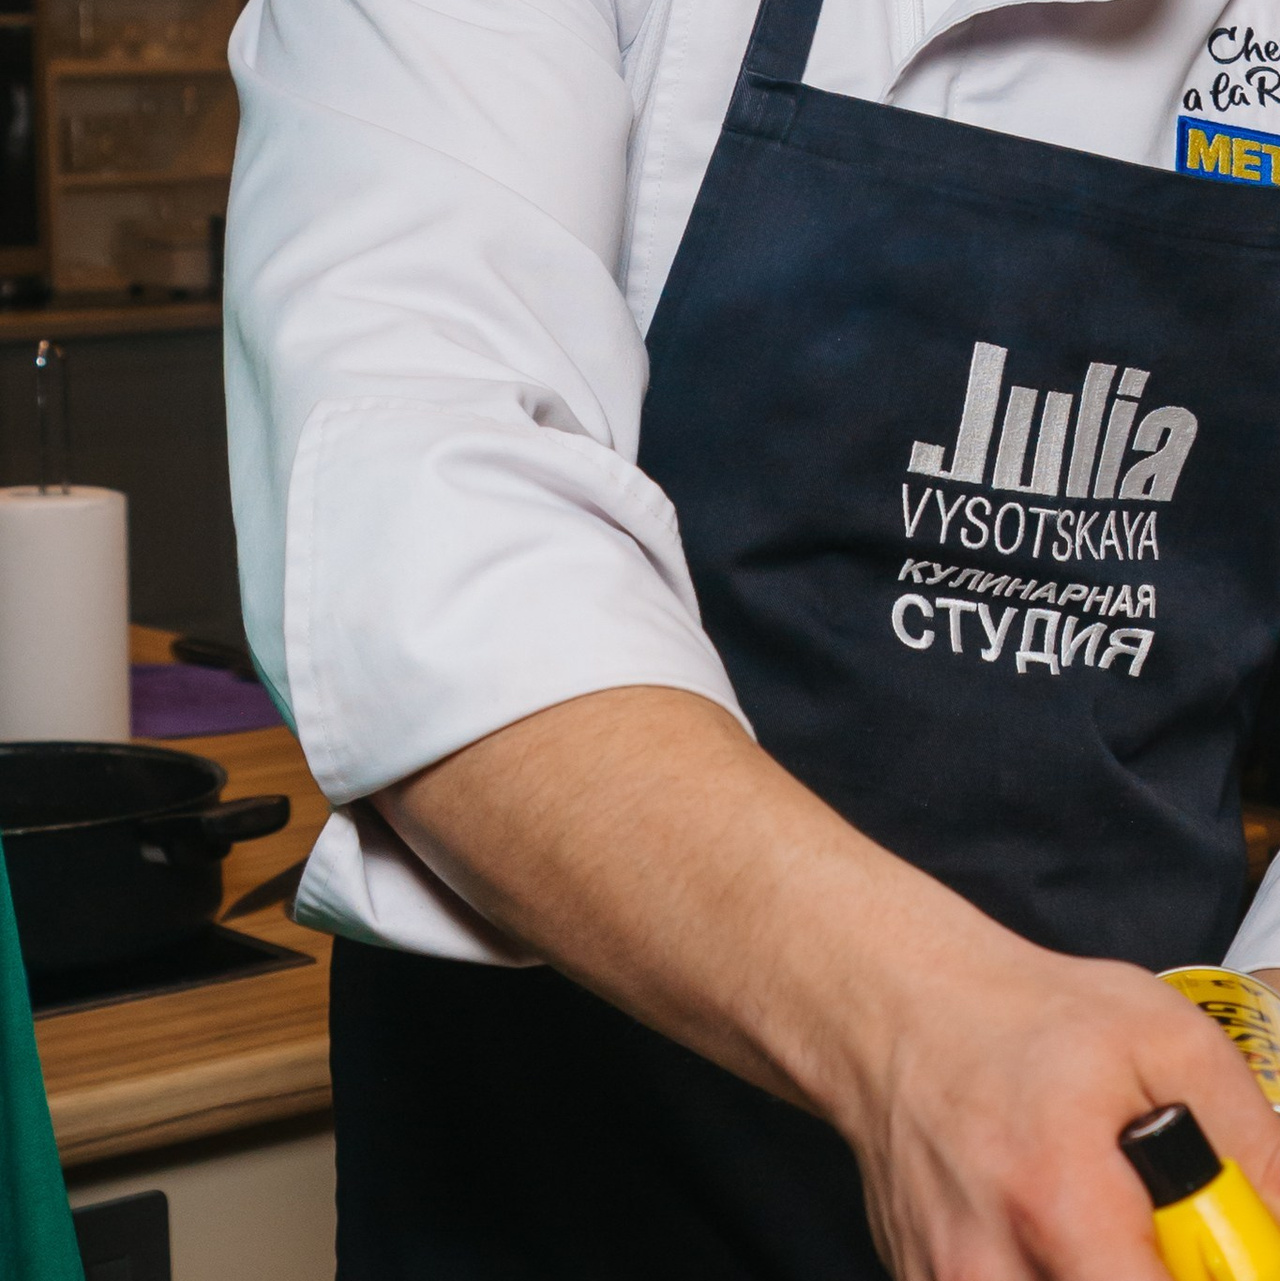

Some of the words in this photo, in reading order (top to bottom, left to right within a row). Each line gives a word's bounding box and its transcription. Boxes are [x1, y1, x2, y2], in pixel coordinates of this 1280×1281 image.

[1183, 88, 1203, 112] a
[907, 340, 1199, 502] Julia
[901, 483, 1160, 562] VYSOTSKAYA
[897, 558, 1157, 619] КУЛИНАРНАЯ
[891, 592, 1156, 678] СТУДИЯ
